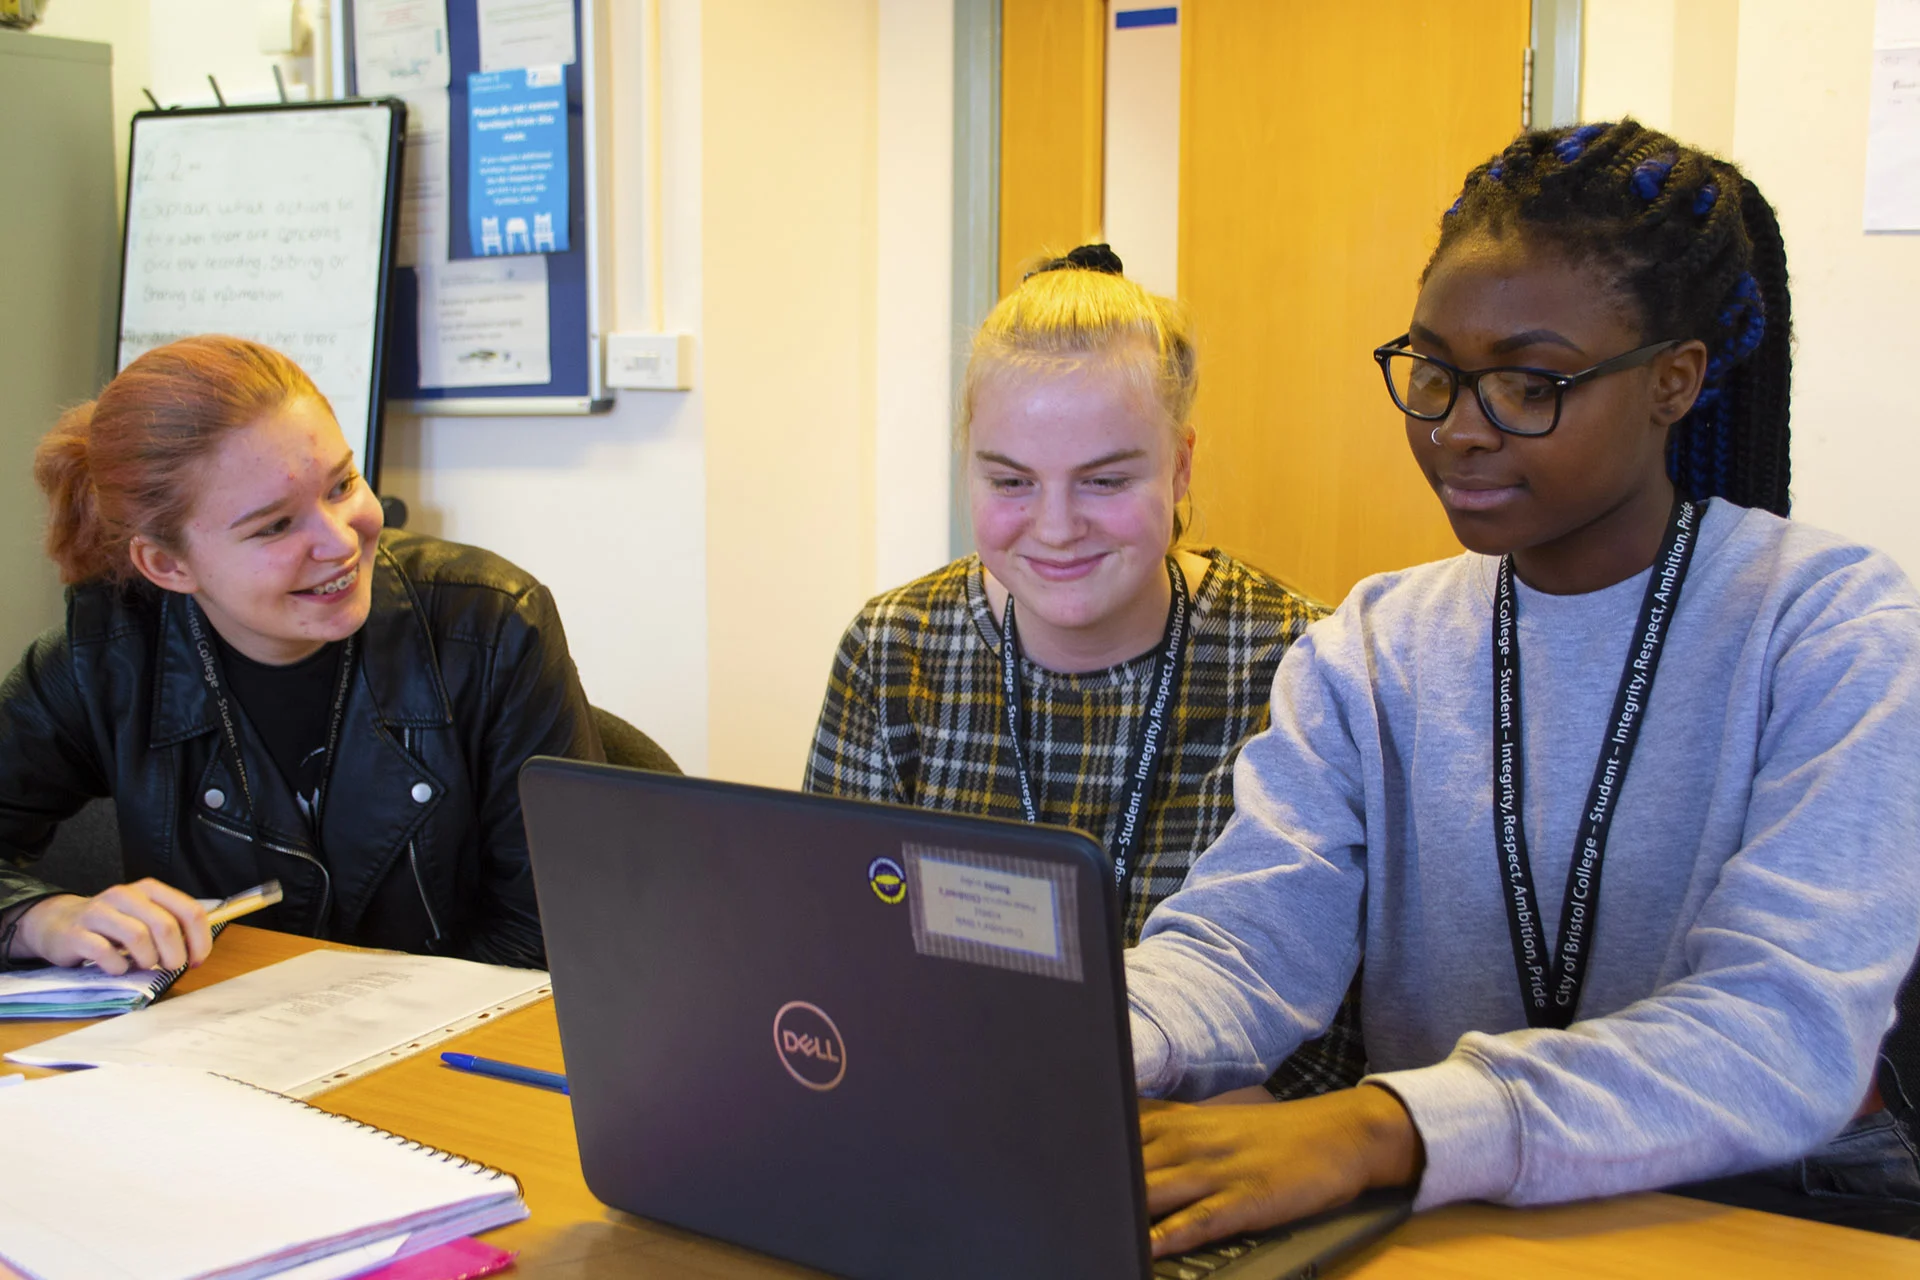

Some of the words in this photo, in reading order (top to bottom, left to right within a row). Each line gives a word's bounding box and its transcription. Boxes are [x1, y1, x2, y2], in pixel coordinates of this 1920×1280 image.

[1498, 599, 1512, 655] College
[197, 640, 219, 689] College
[217, 697, 237, 749] Student
[1500, 668, 1513, 728] Student
[1003, 641, 1014, 693] College
[1019, 770, 1036, 825] Integrit
[1590, 757, 1620, 822] Student
[1118, 791, 1142, 846] Student
[1573, 837, 1598, 899] College
[1563, 901, 1587, 953] Bristol
[1556, 974, 1577, 1005] City
[1562, 954, 1577, 972] of
[782, 1029, 840, 1063] DELL
